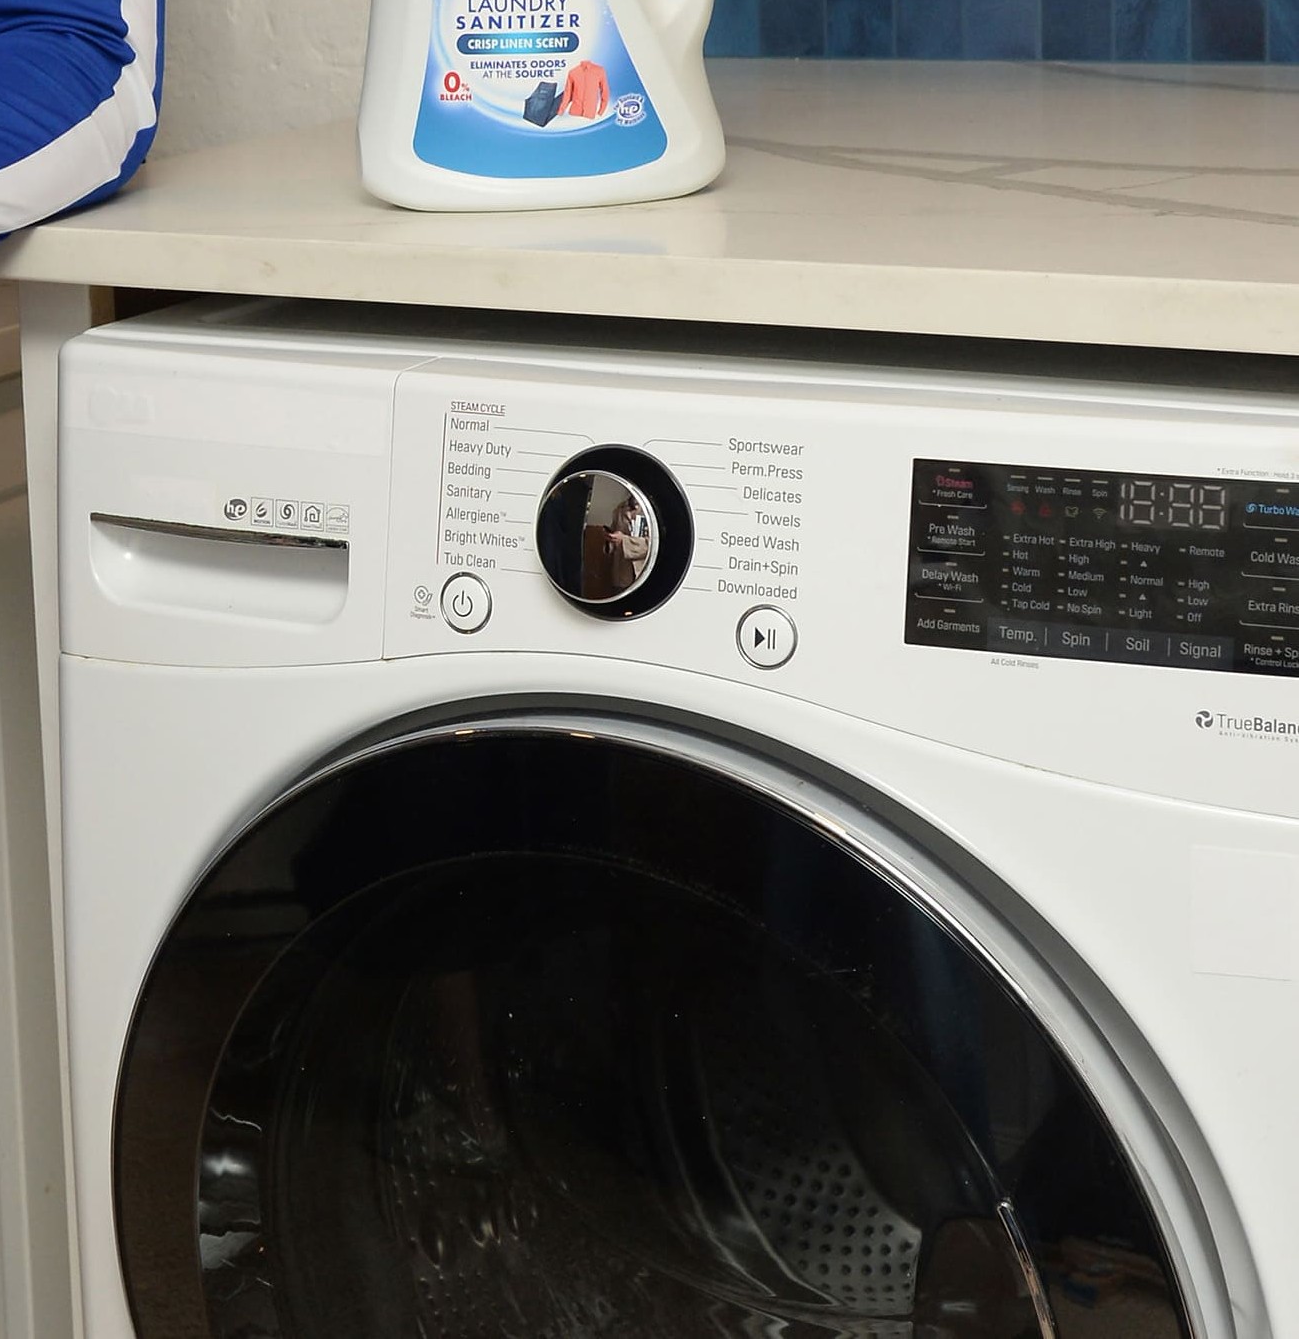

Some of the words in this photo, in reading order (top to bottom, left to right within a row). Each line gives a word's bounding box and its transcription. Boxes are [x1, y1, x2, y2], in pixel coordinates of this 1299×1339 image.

[456, 14, 580, 30] SANITIZER
[467, 38, 498, 50] CRISP
[499, 37, 533, 50] LINEN
[535, 36, 569, 48] SCENT
[470, 60, 528, 70] ELIMINATES
[530, 59, 566, 69] ODORS
[482, 71, 495, 79] AT
[496, 70, 512, 78] THE
[440, 93, 472, 102] BLEACH
[451, 401, 479, 412] STEAM
[480, 403, 506, 414] CYCLE
[450, 418, 490, 432] Normal
[449, 440, 483, 456] Heavy
[485, 442, 512, 457] Duty
[729, 438, 804, 456] Sportswear
[448, 462, 491, 479] Bedding
[731, 461, 804, 480] Perm.Press
[446, 485, 492, 501] Sanitary
[743, 486, 802, 504] Delicates
[937, 489, 955, 498] Fresh
[956, 491, 973, 500] Care
[1035, 484, 1056, 494] Wash
[1062, 486, 1082, 496] Rinse
[1092, 488, 1108, 499] Spin
[755, 511, 801, 528] Towels
[929, 523, 945, 535] Pre
[947, 525, 976, 537] Wash
[444, 530, 477, 546] Bright
[721, 532, 760, 548] Speed
[763, 536, 800, 552] Wash
[931, 536, 957, 546] Remote
[958, 537, 976, 547] Start
[1013, 534, 1037, 545] Extra
[1038, 536, 1055, 546] Hot
[1069, 537, 1094, 548] Extra
[1096, 538, 1116, 551] High
[1131, 541, 1161, 555] Heavy
[1189, 546, 1225, 558] Remote
[444, 552, 464, 566] Tub
[466, 554, 496, 569] Clean
[1012, 550, 1029, 561] Hot
[1068, 554, 1090, 566] High
[1251, 551, 1275, 563] Cold
[728, 556, 799, 577] Drain+Spin
[1013, 566, 1041, 578] Warm
[922, 568, 949, 582] Delay
[950, 571, 979, 584] Wash
[1068, 569, 1105, 582] Medium
[1130, 575, 1164, 587] Normal
[718, 579, 798, 600] Downloaded
[943, 584, 962, 592] Wi-Fi
[1011, 582, 1032, 593] Cold
[1067, 586, 1088, 598] Low
[1188, 579, 1210, 592] High
[1012, 598, 1030, 610] Tap
[1031, 600, 1050, 611] Cold
[1187, 595, 1209, 606] Low
[1248, 600, 1276, 612] Extra
[1067, 603, 1081, 613] No
[1082, 604, 1102, 617] Spin
[1129, 608, 1152, 620] Light
[1187, 612, 1203, 623] Off
[917, 618, 936, 629] Add
[937, 619, 981, 634] Garments
[999, 625, 1037, 643] Temp.
[1062, 631, 1091, 647] Spin
[1125, 637, 1150, 651] Soil
[1179, 642, 1221, 659] Signal
[1244, 643, 1273, 656] Rinse
[1001, 659, 1016, 667] Cold
[1255, 658, 1282, 667] Control
[1216, 713, 1299, 735] TrueBalan
